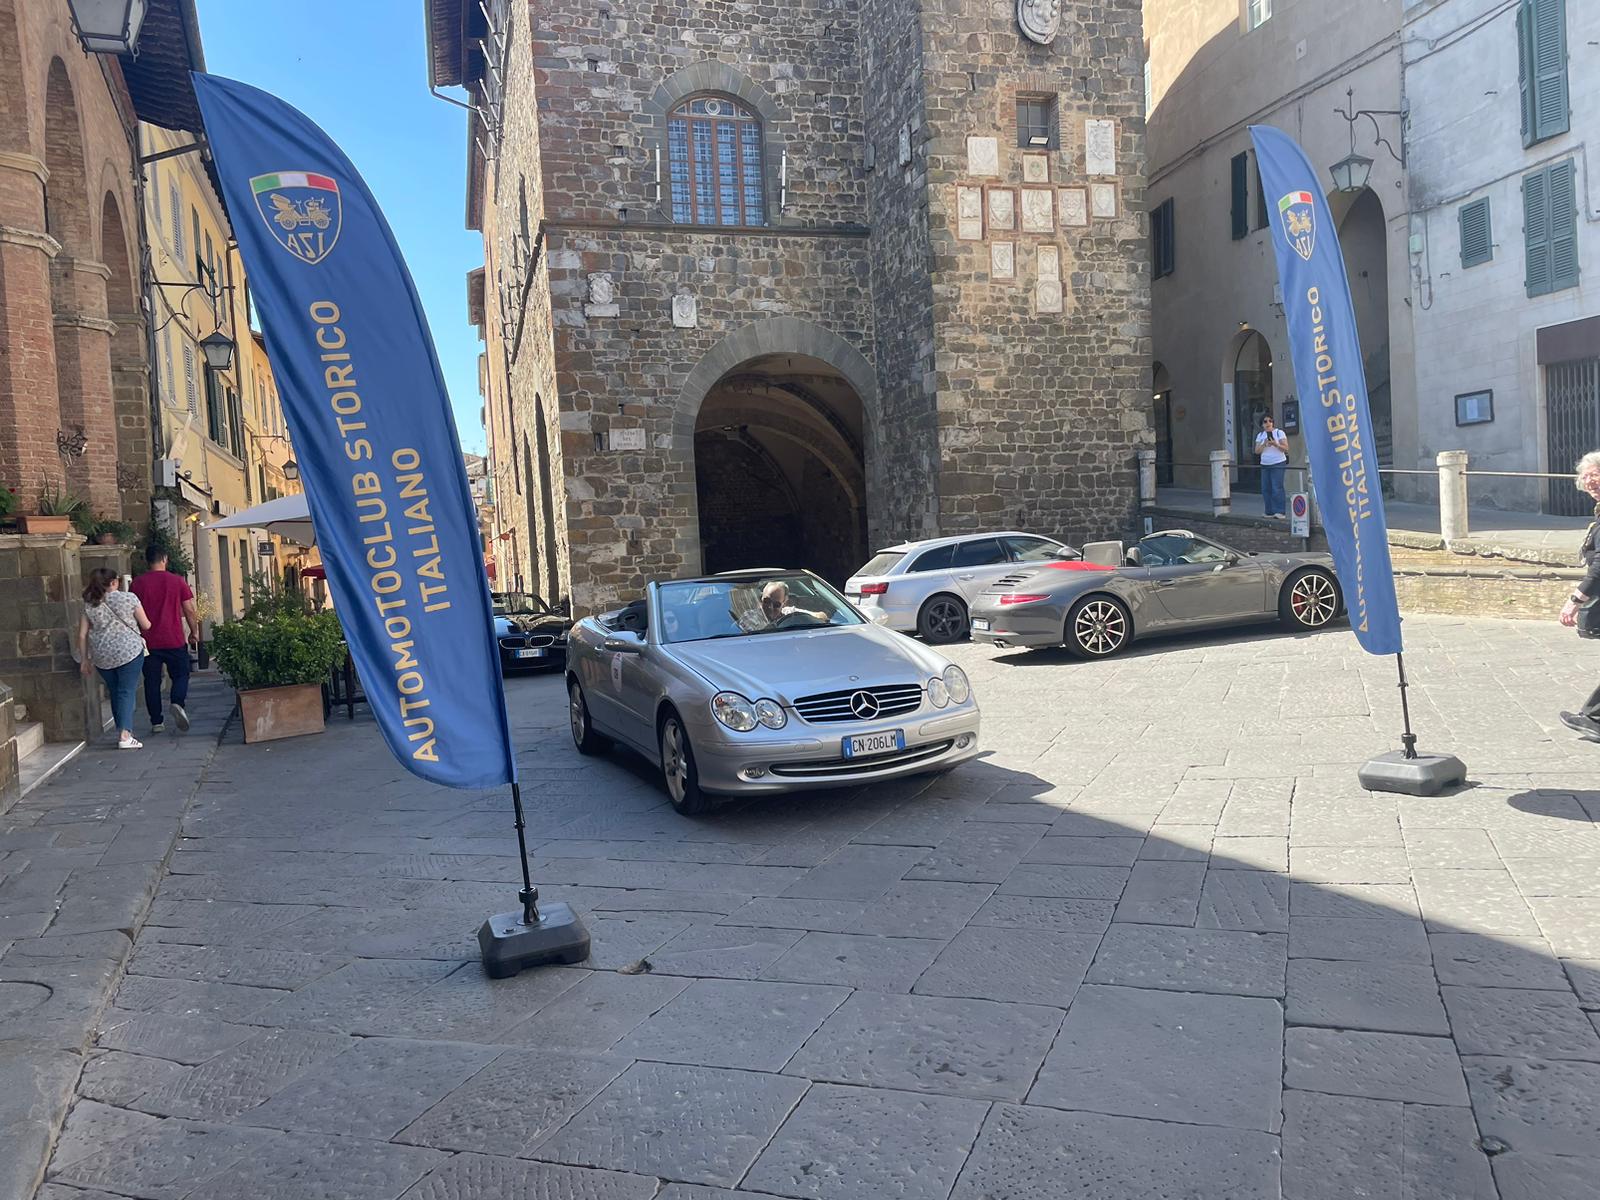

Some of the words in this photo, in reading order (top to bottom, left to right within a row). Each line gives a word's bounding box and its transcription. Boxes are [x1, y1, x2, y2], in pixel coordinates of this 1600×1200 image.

[309, 300, 374, 462] STORICO
[1306, 286, 1341, 409] STORICO
[391, 447, 451, 613] ITALIANO
[1326, 412, 1369, 633] AUTOMOTOCLUB
[1345, 393, 1372, 520] ITALIANO
[352, 471, 440, 762] AUTOMOTOCLUB
[852, 739, 865, 753] CN
[867, 734, 897, 751] 206LM
